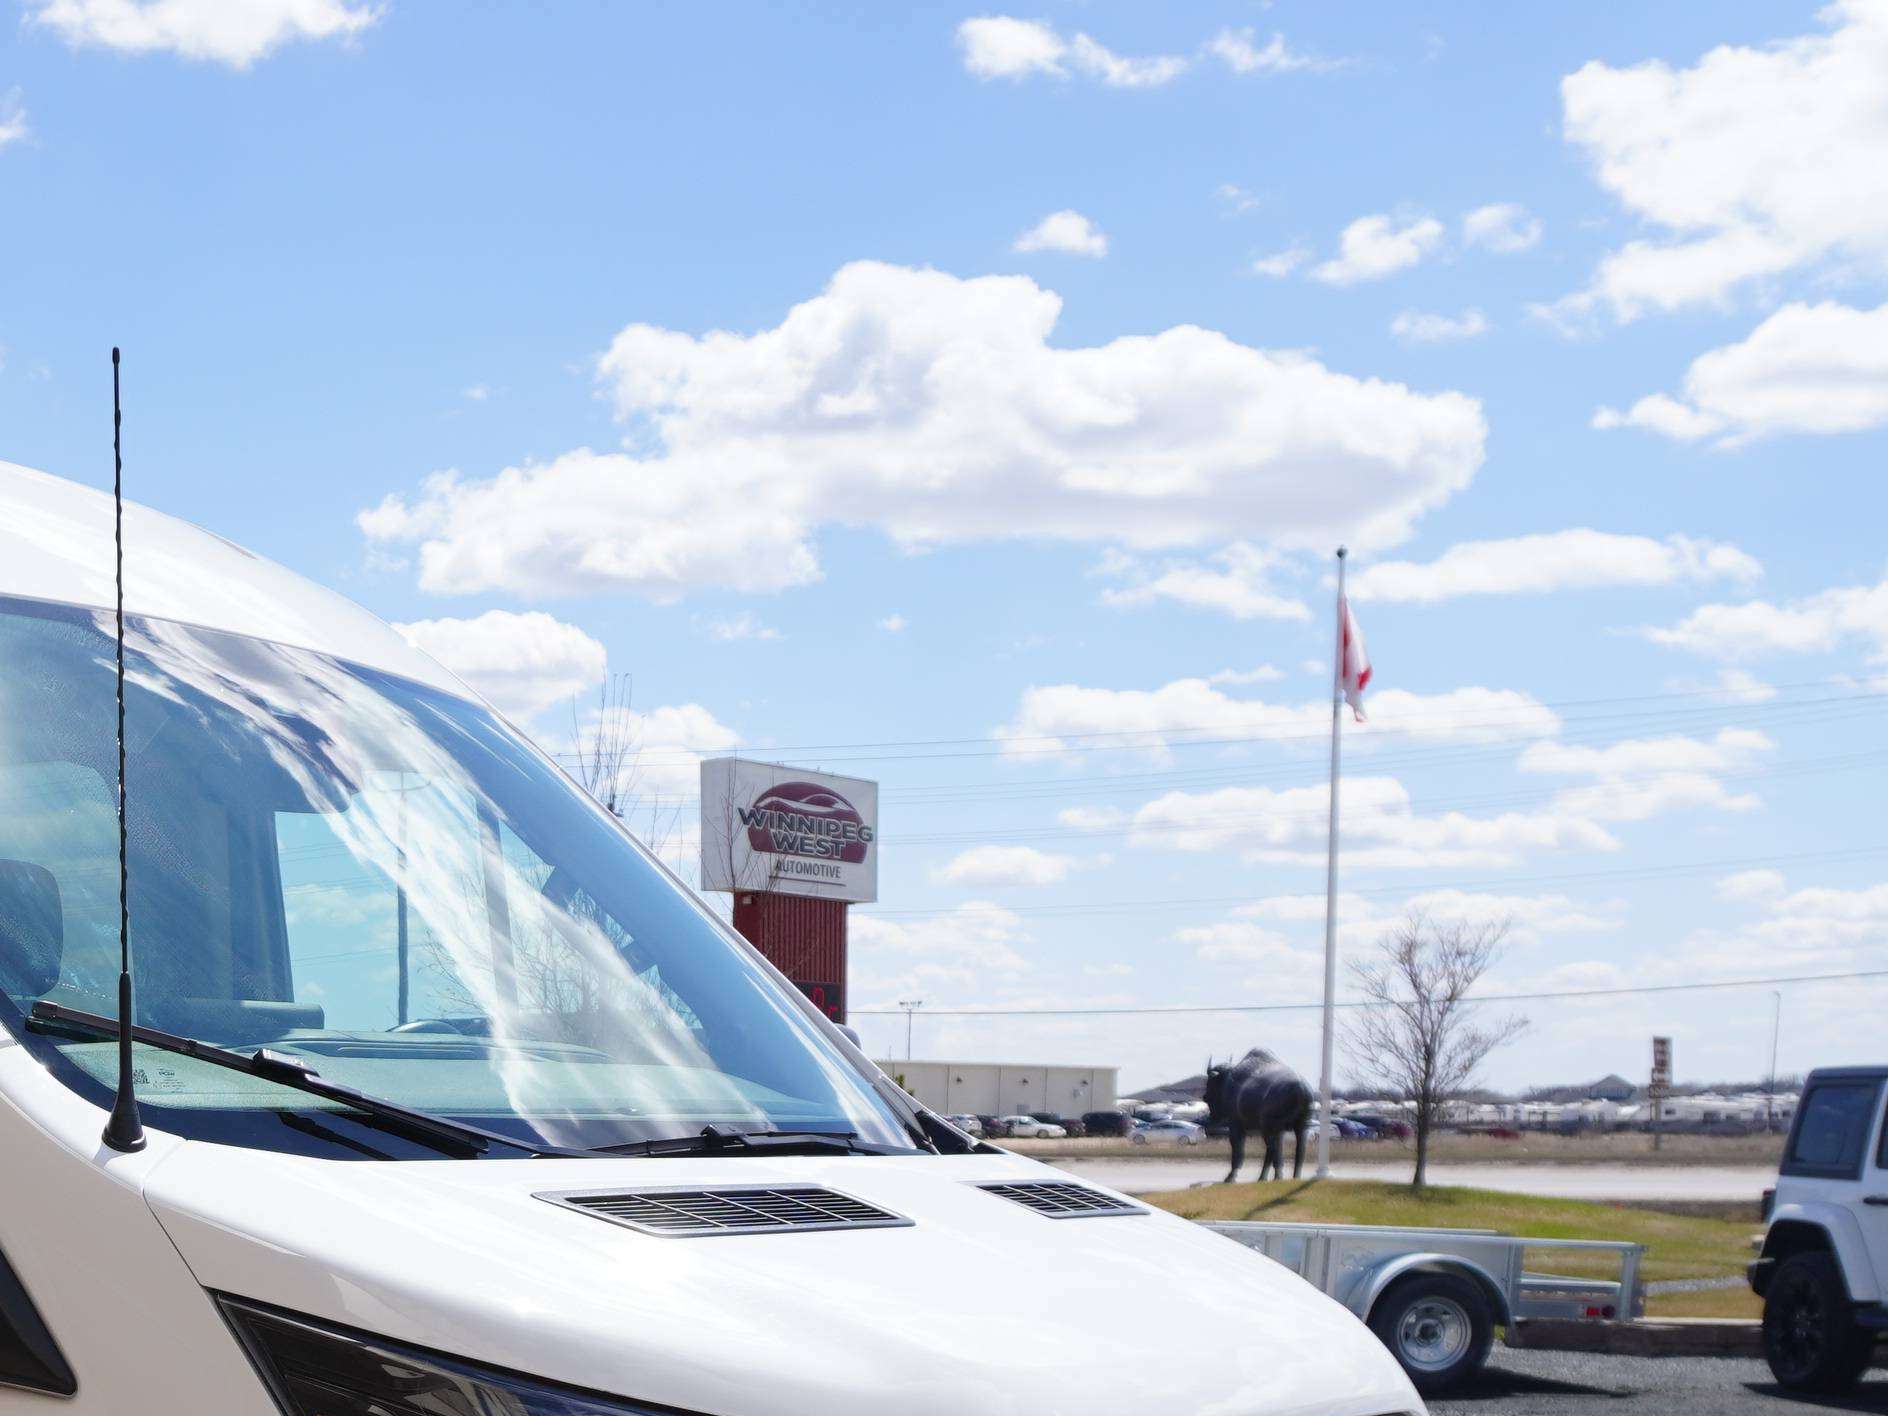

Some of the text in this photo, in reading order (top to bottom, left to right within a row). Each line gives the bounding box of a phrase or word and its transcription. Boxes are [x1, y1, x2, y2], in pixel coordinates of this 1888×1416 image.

[738, 807, 873, 842] WINNIPEG
[771, 831, 845, 858] WEST
[776, 860, 841, 879] AUTOMOTIVE
